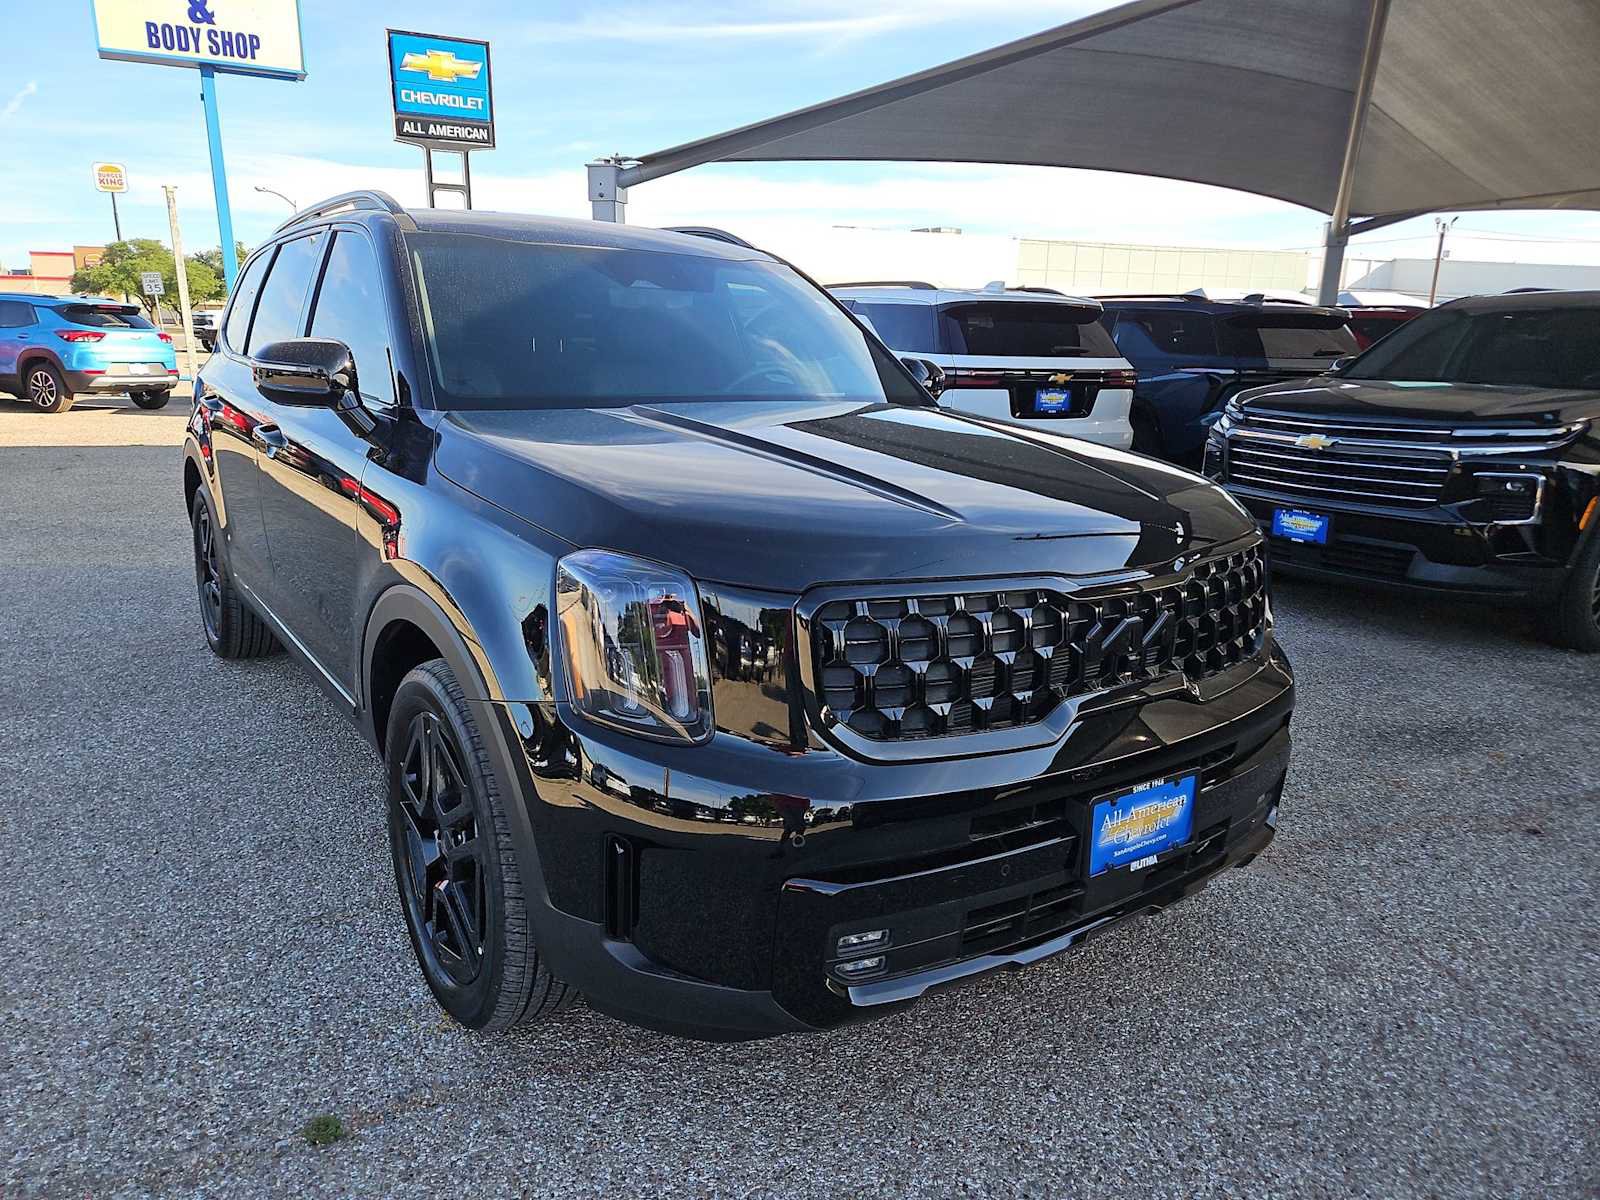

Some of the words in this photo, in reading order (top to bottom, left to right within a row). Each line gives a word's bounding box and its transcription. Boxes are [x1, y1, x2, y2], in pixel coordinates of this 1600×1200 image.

[145, 21, 201, 53] BODY
[207, 29, 261, 60] SHOP
[400, 89, 485, 110] CHEVROLET
[402, 121, 426, 135] ALL
[428, 124, 488, 140] AMERICAN
[98, 178, 124, 186] KING
[146, 283, 162, 292] 35
[1132, 782, 1151, 794] SINCE
[1101, 809, 1123, 832] All
[1125, 794, 1187, 824] American
